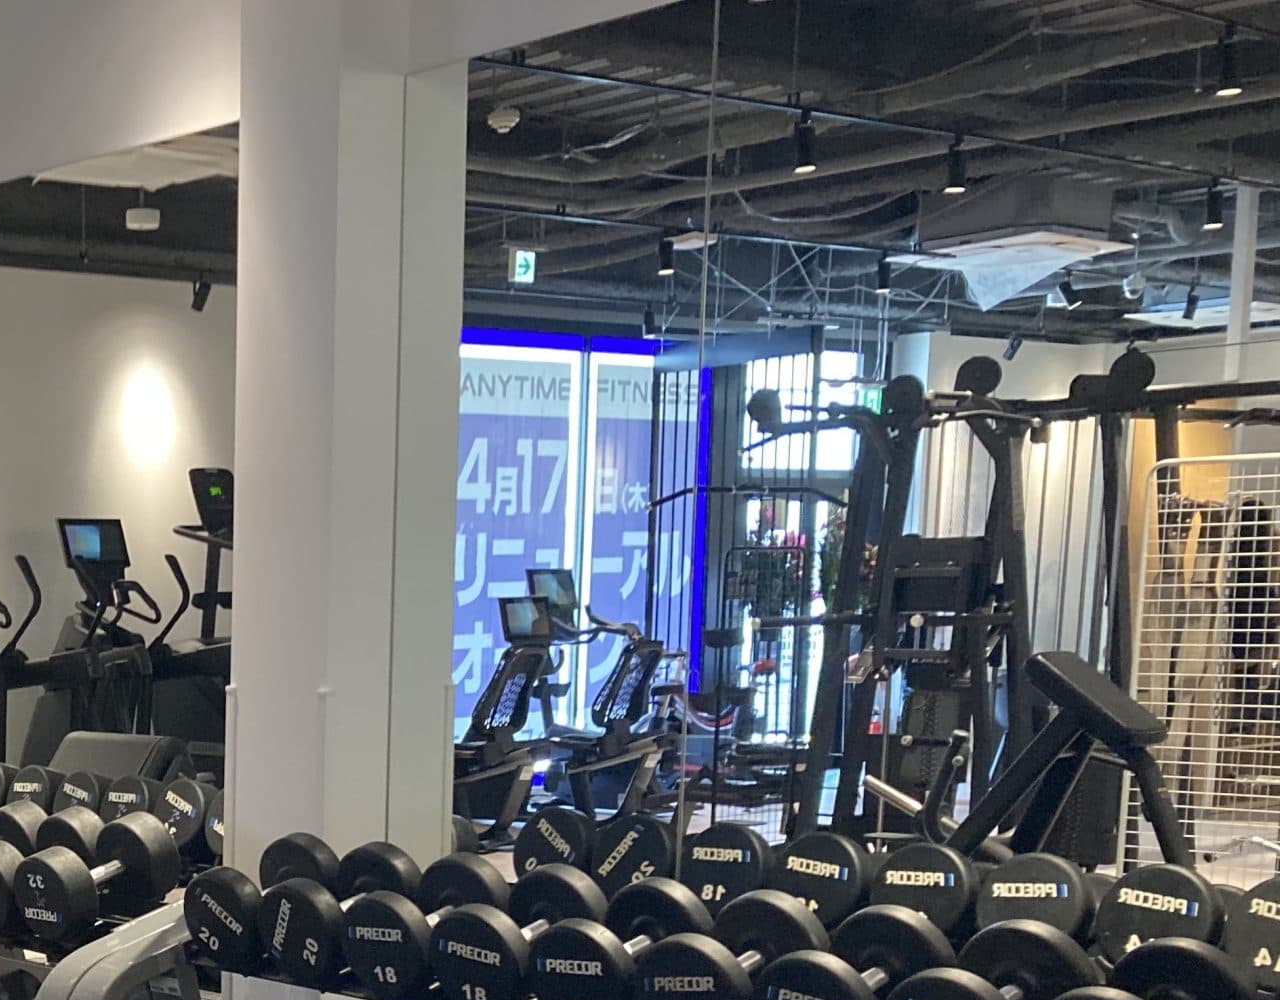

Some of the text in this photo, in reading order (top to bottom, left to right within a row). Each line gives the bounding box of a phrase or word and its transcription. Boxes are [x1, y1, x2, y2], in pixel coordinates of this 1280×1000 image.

[460, 372, 570, 401] ANYTIME
[457, 437, 649, 516] 4月17日(木
[27, 874, 45, 889] 32
[24, 907, 58, 922] PRECOR
[201, 894, 243, 936] PRECOR
[273, 898, 292, 951] PRECOR
[199, 927, 219, 950] 20
[356, 927, 403, 942] PRECOR
[303, 938, 319, 965] 20
[448, 941, 501, 967] PRECOR
[374, 965, 397, 983] 18
[546, 959, 603, 976] PRECOR
[654, 976, 716, 992] PRECOR
